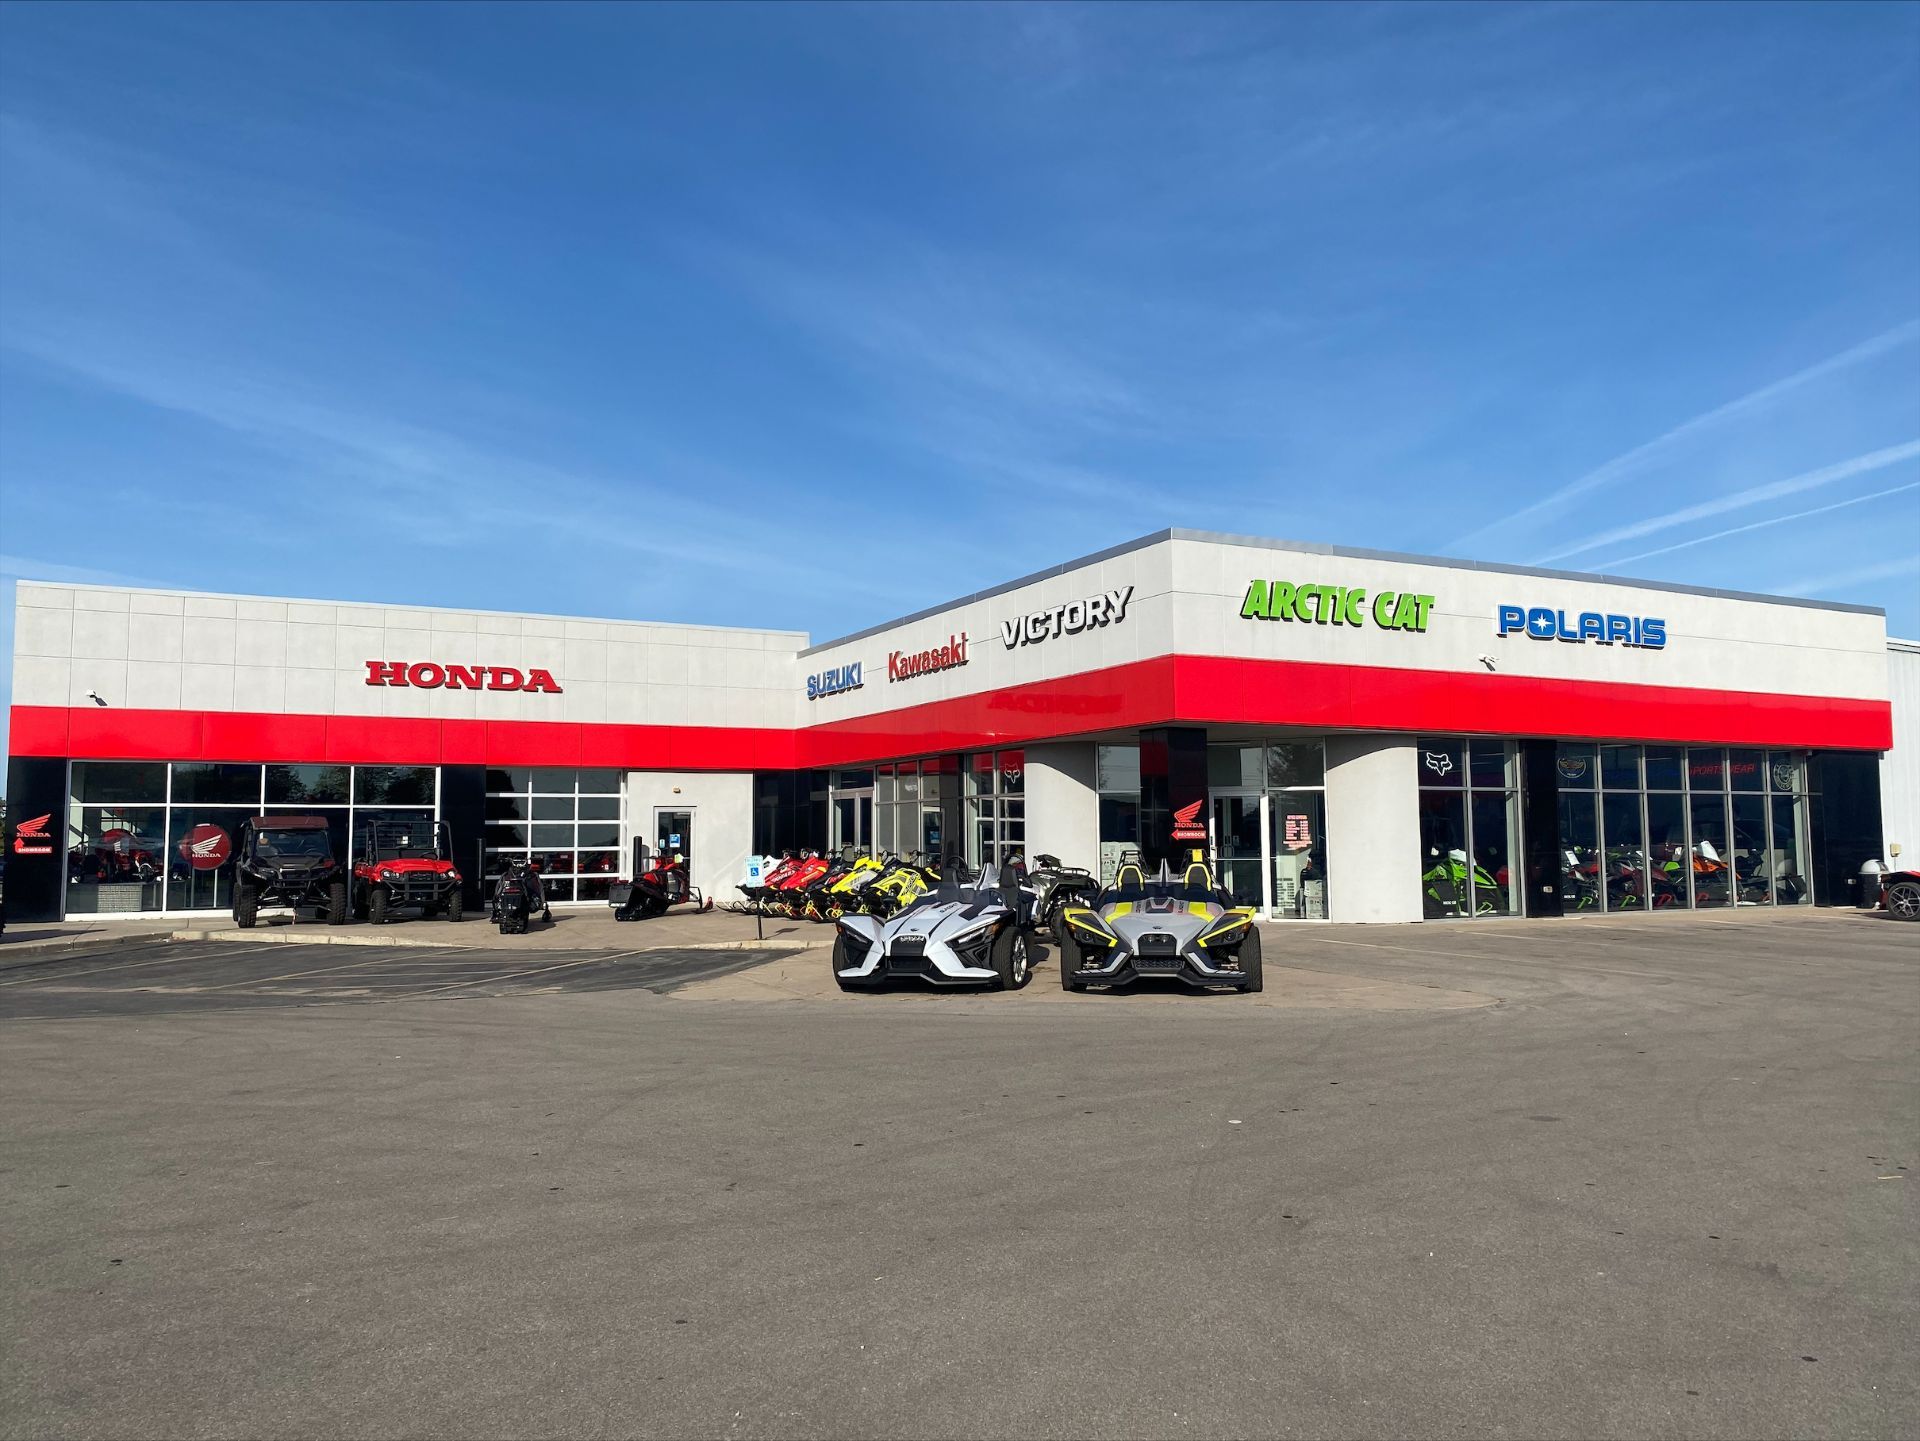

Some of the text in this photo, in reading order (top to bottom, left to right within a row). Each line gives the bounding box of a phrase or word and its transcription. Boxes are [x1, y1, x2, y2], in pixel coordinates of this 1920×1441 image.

[1000, 586, 1134, 650] VICTORY
[1240, 579, 1435, 632] ARCTIC CAT
[1497, 604, 1666, 650] POLARIS
[366, 661, 563, 693] HONDA
[807, 661, 864, 700] SUZUKI
[888, 632, 969, 683] Kawasaki
